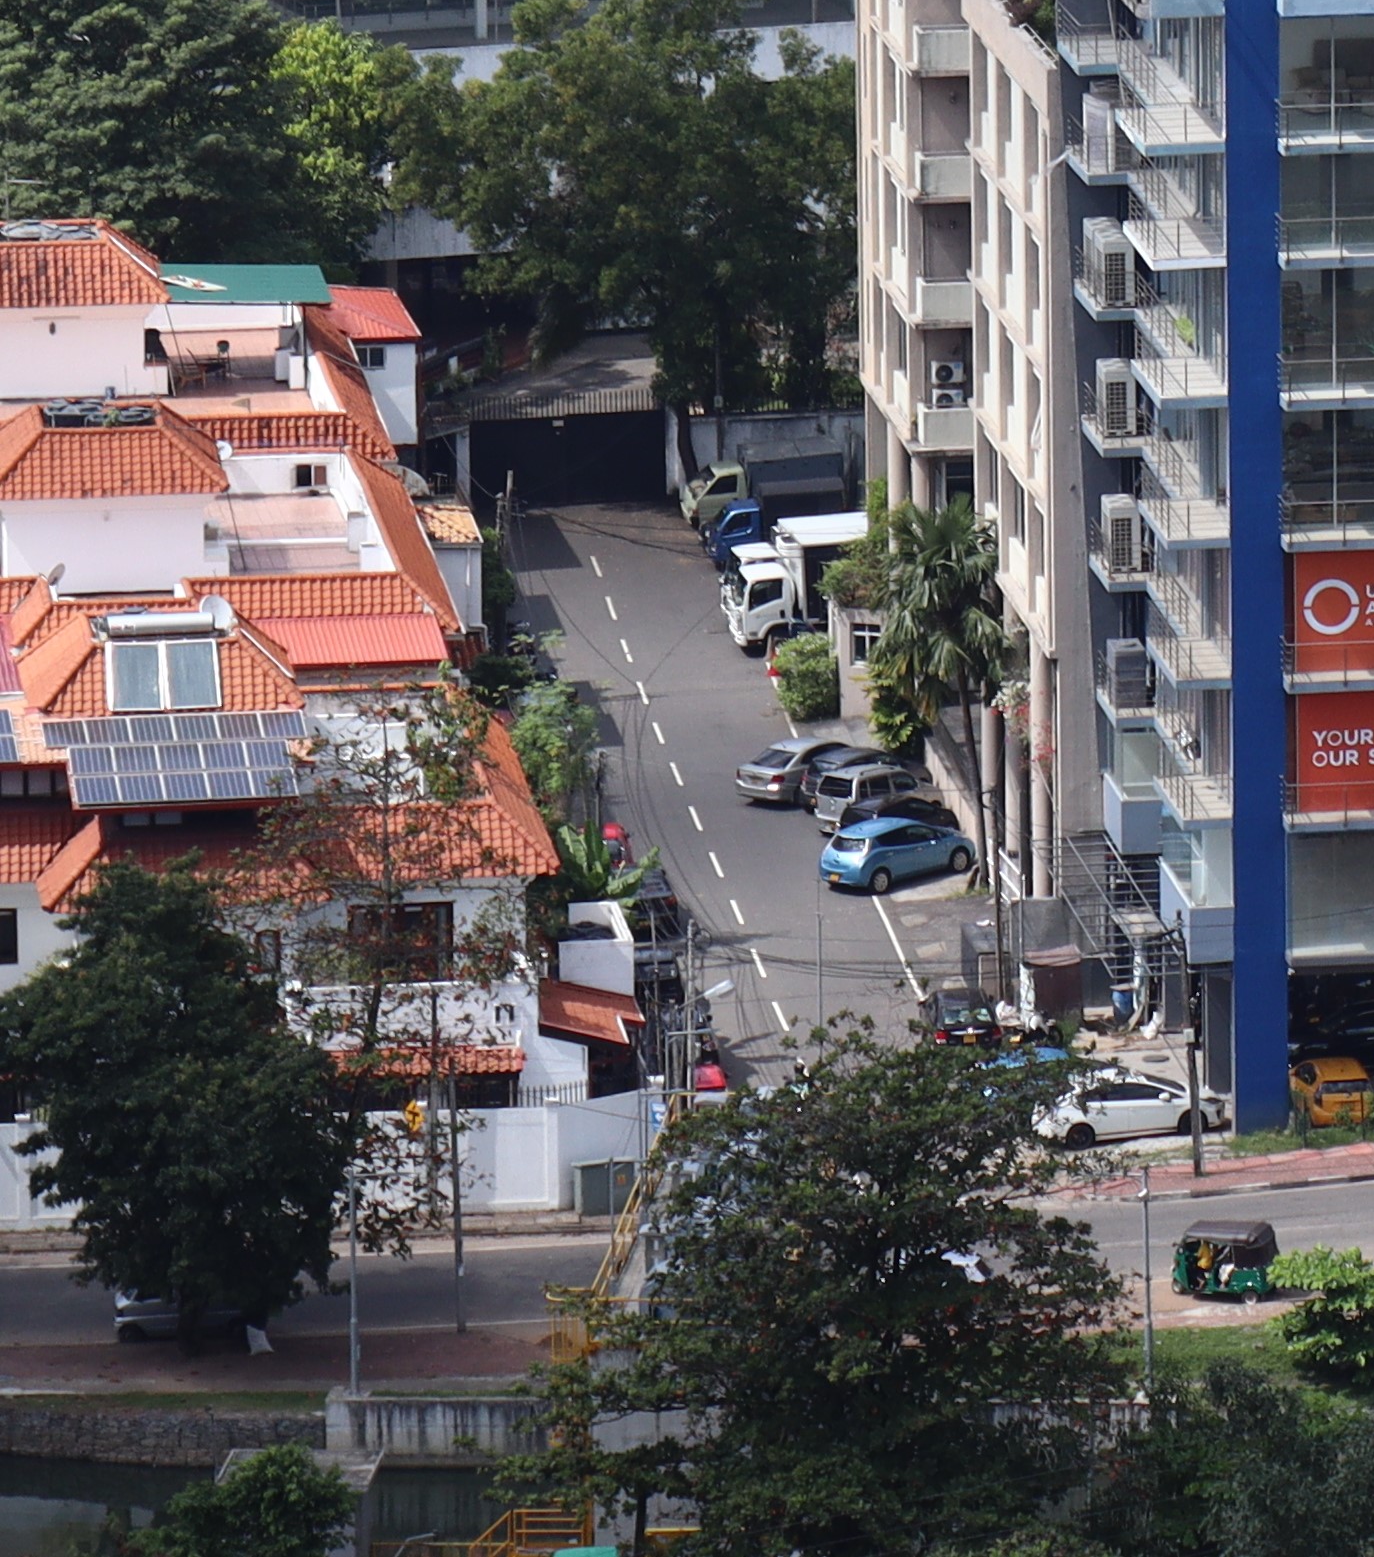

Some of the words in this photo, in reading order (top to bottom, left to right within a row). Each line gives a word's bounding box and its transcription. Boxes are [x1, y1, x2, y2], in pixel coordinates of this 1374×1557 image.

[1365, 618, 1374, 626] A
[1312, 728, 1374, 747] YOUR
[1312, 750, 1359, 767] OUR
